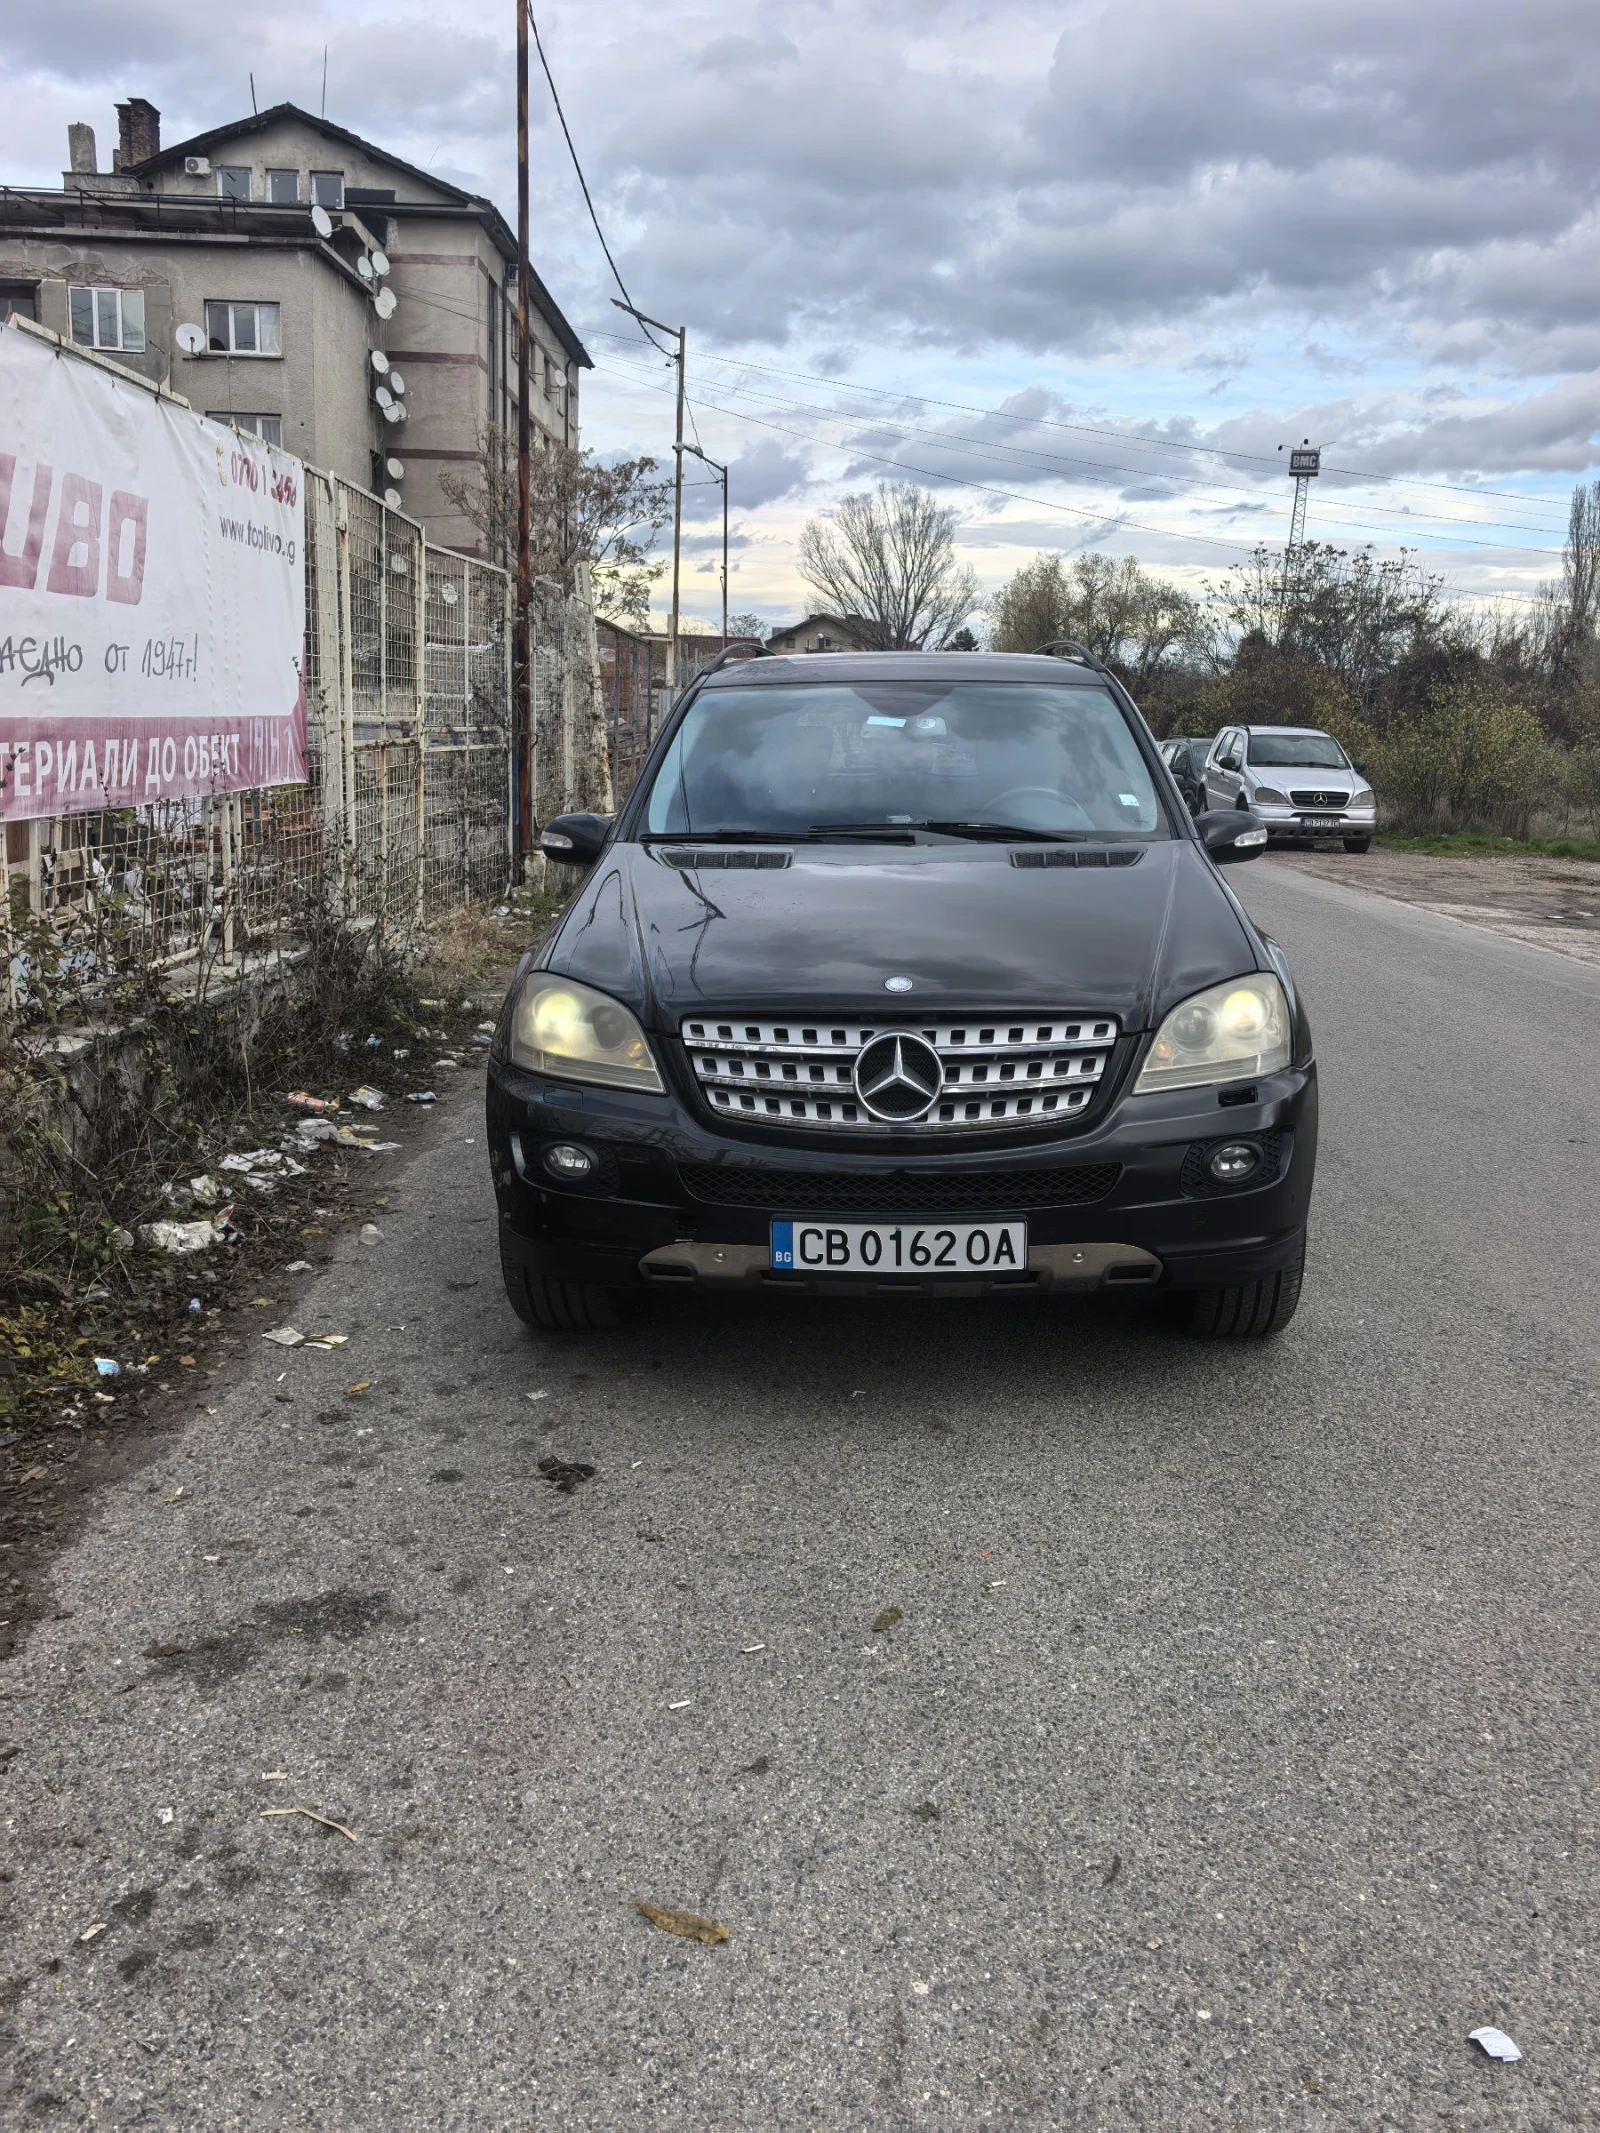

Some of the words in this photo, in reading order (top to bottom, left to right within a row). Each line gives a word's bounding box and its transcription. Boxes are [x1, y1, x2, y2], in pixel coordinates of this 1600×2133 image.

[1293, 455, 1317, 468] BMC
[145, 736, 177, 796] ДО
[184, 733, 240, 781] ОБЕКТ
[775, 1251, 792, 1263] BG
